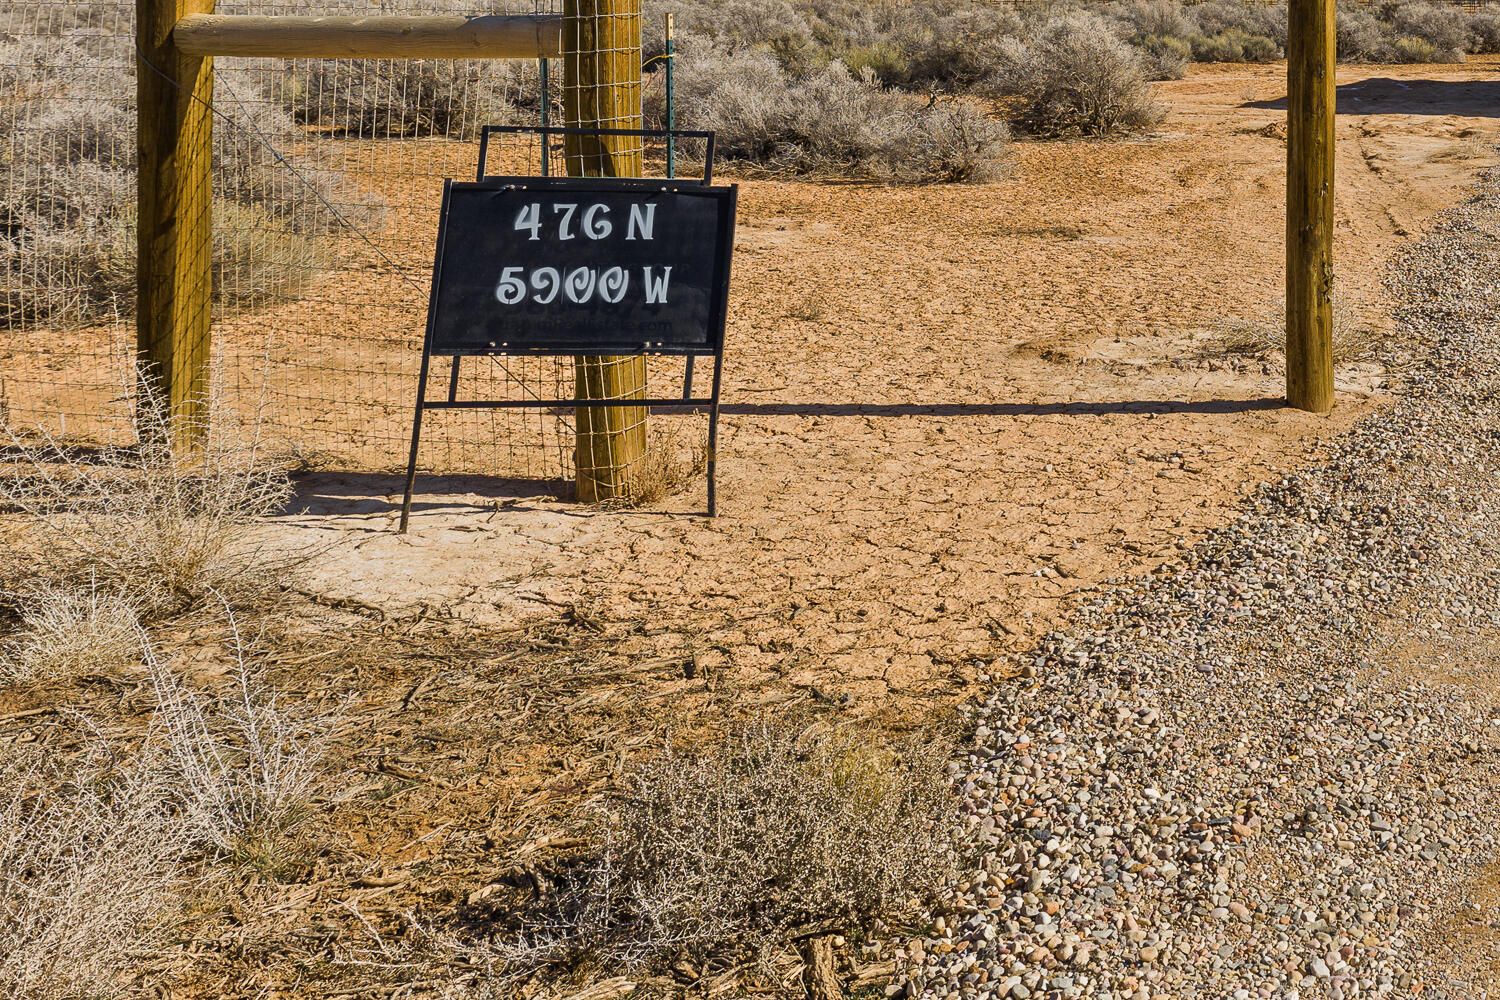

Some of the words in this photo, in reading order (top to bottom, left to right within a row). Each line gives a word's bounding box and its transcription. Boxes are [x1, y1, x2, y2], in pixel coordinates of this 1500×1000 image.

[514, 203, 613, 241] 476
[625, 203, 658, 241] N
[496, 265, 629, 305] 5900
[643, 266, 673, 304] W
